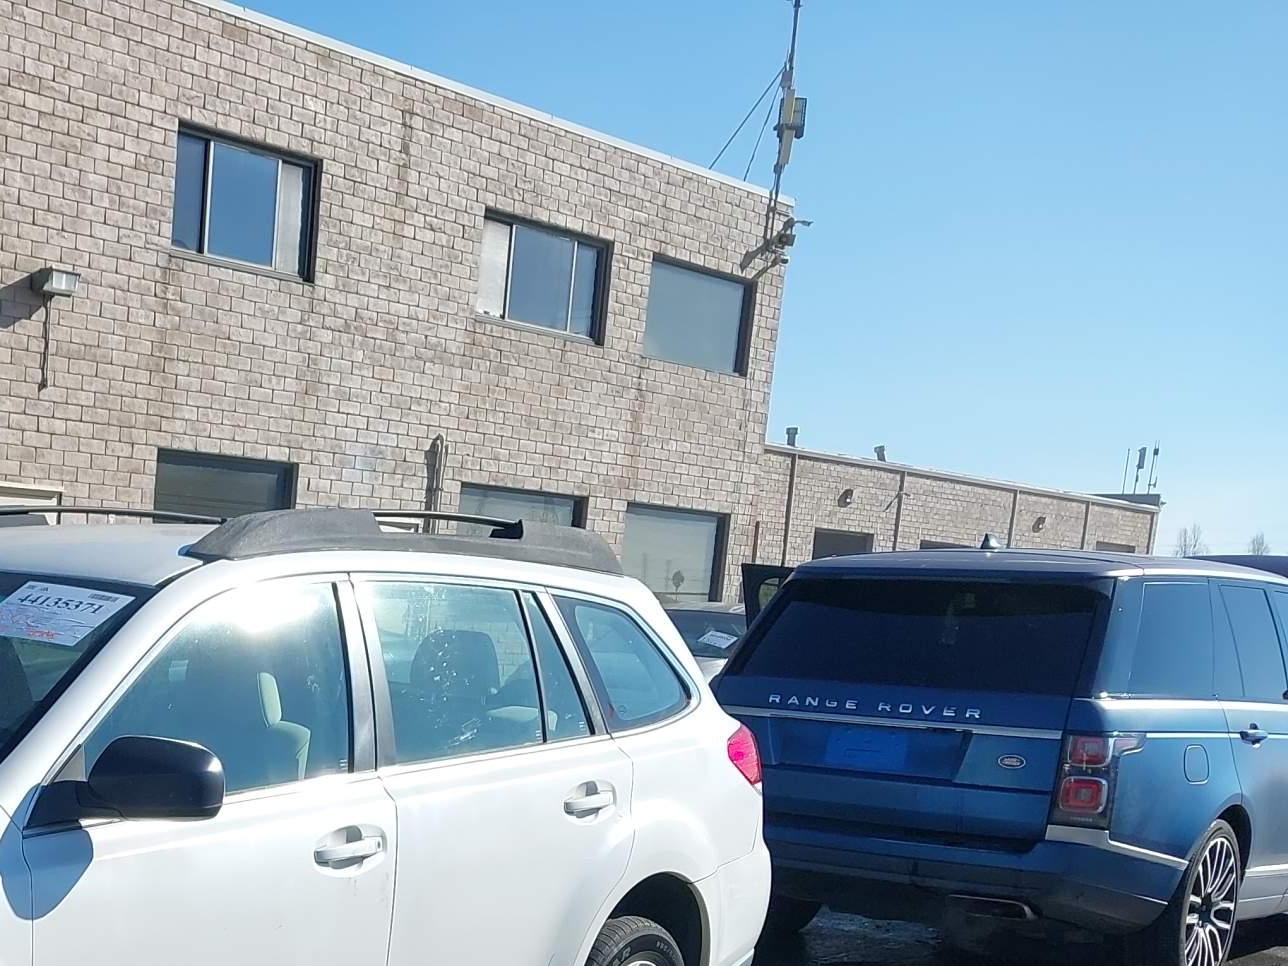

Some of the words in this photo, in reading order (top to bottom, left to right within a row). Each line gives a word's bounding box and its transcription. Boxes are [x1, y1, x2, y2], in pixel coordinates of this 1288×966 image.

[17, 593, 105, 614] 44135371
[768, 693, 858, 710] RANGE
[877, 702, 983, 719] ROVER
